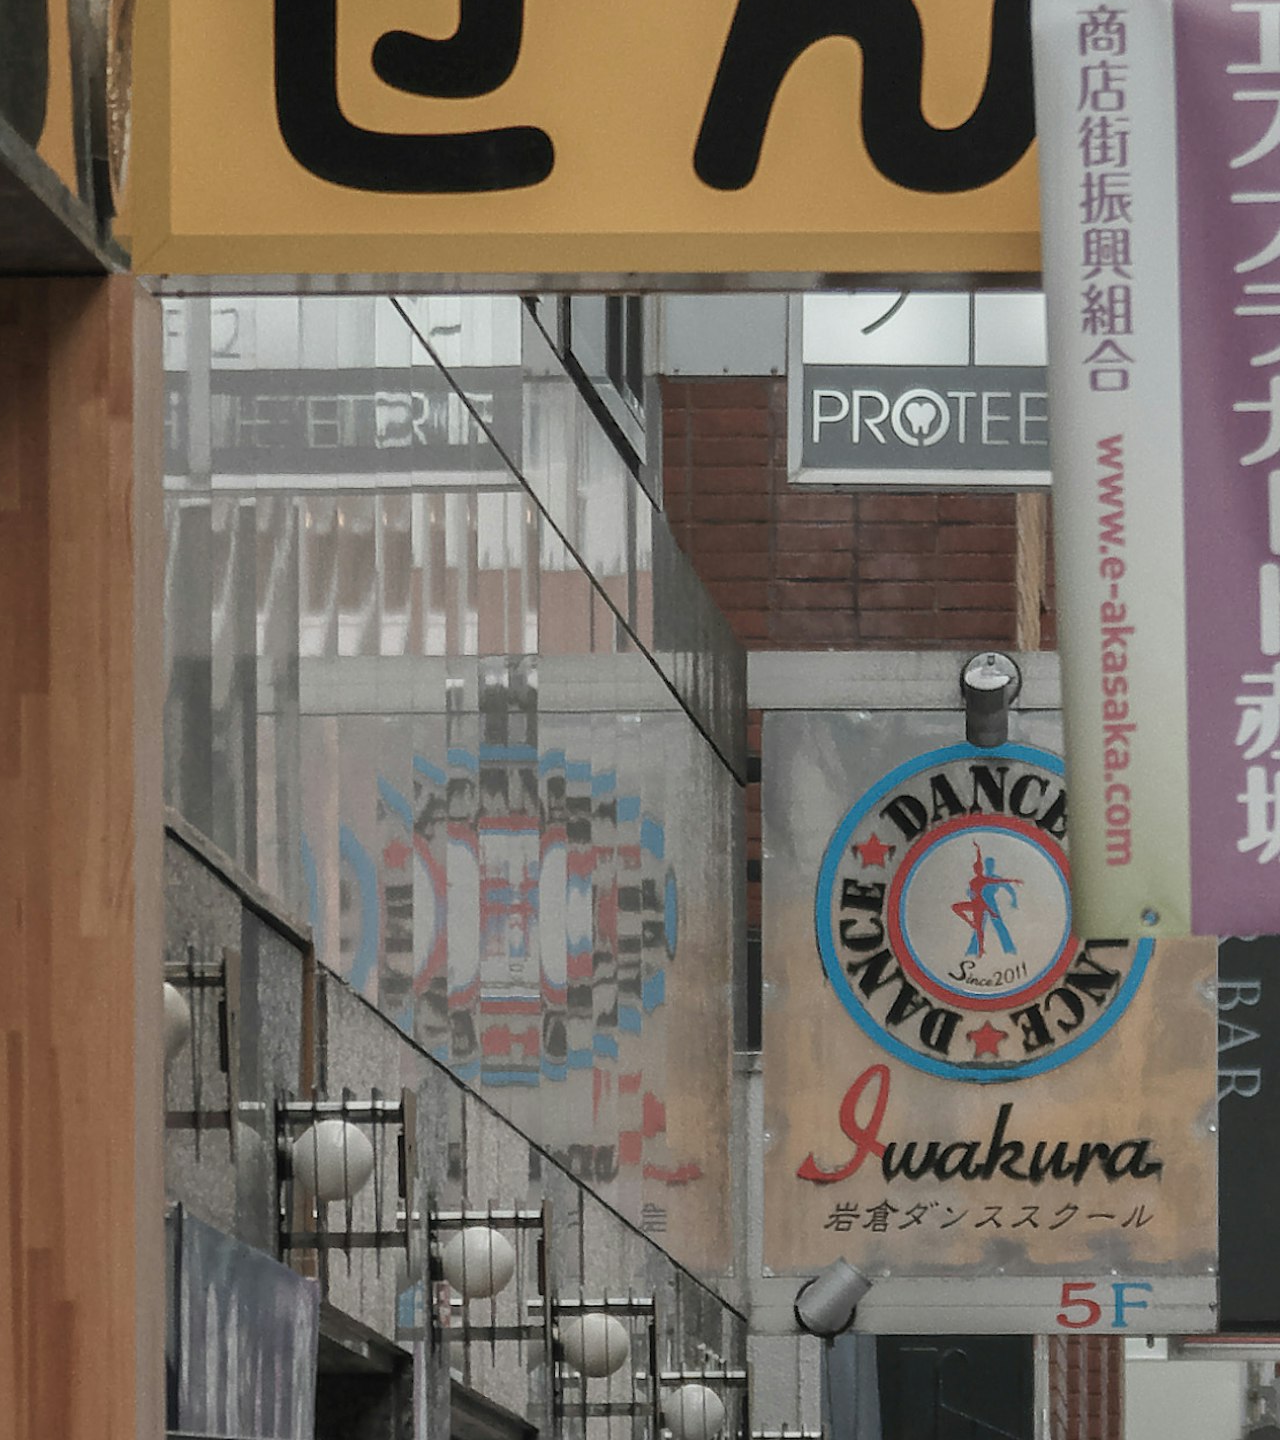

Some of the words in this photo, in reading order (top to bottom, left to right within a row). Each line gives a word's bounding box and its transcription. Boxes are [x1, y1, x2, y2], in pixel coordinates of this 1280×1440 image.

[1076, 2, 1136, 393] 商店街振興組合
[1094, 432, 1139, 868] www.e-akasaka.com
[839, 878, 966, 1058] DANCE
[796, 1062, 1163, 1186] Iwakura
[822, 1200, 1156, 1236] 岩倉ダンススクール
[1055, 1281, 1156, 1330] 5F
